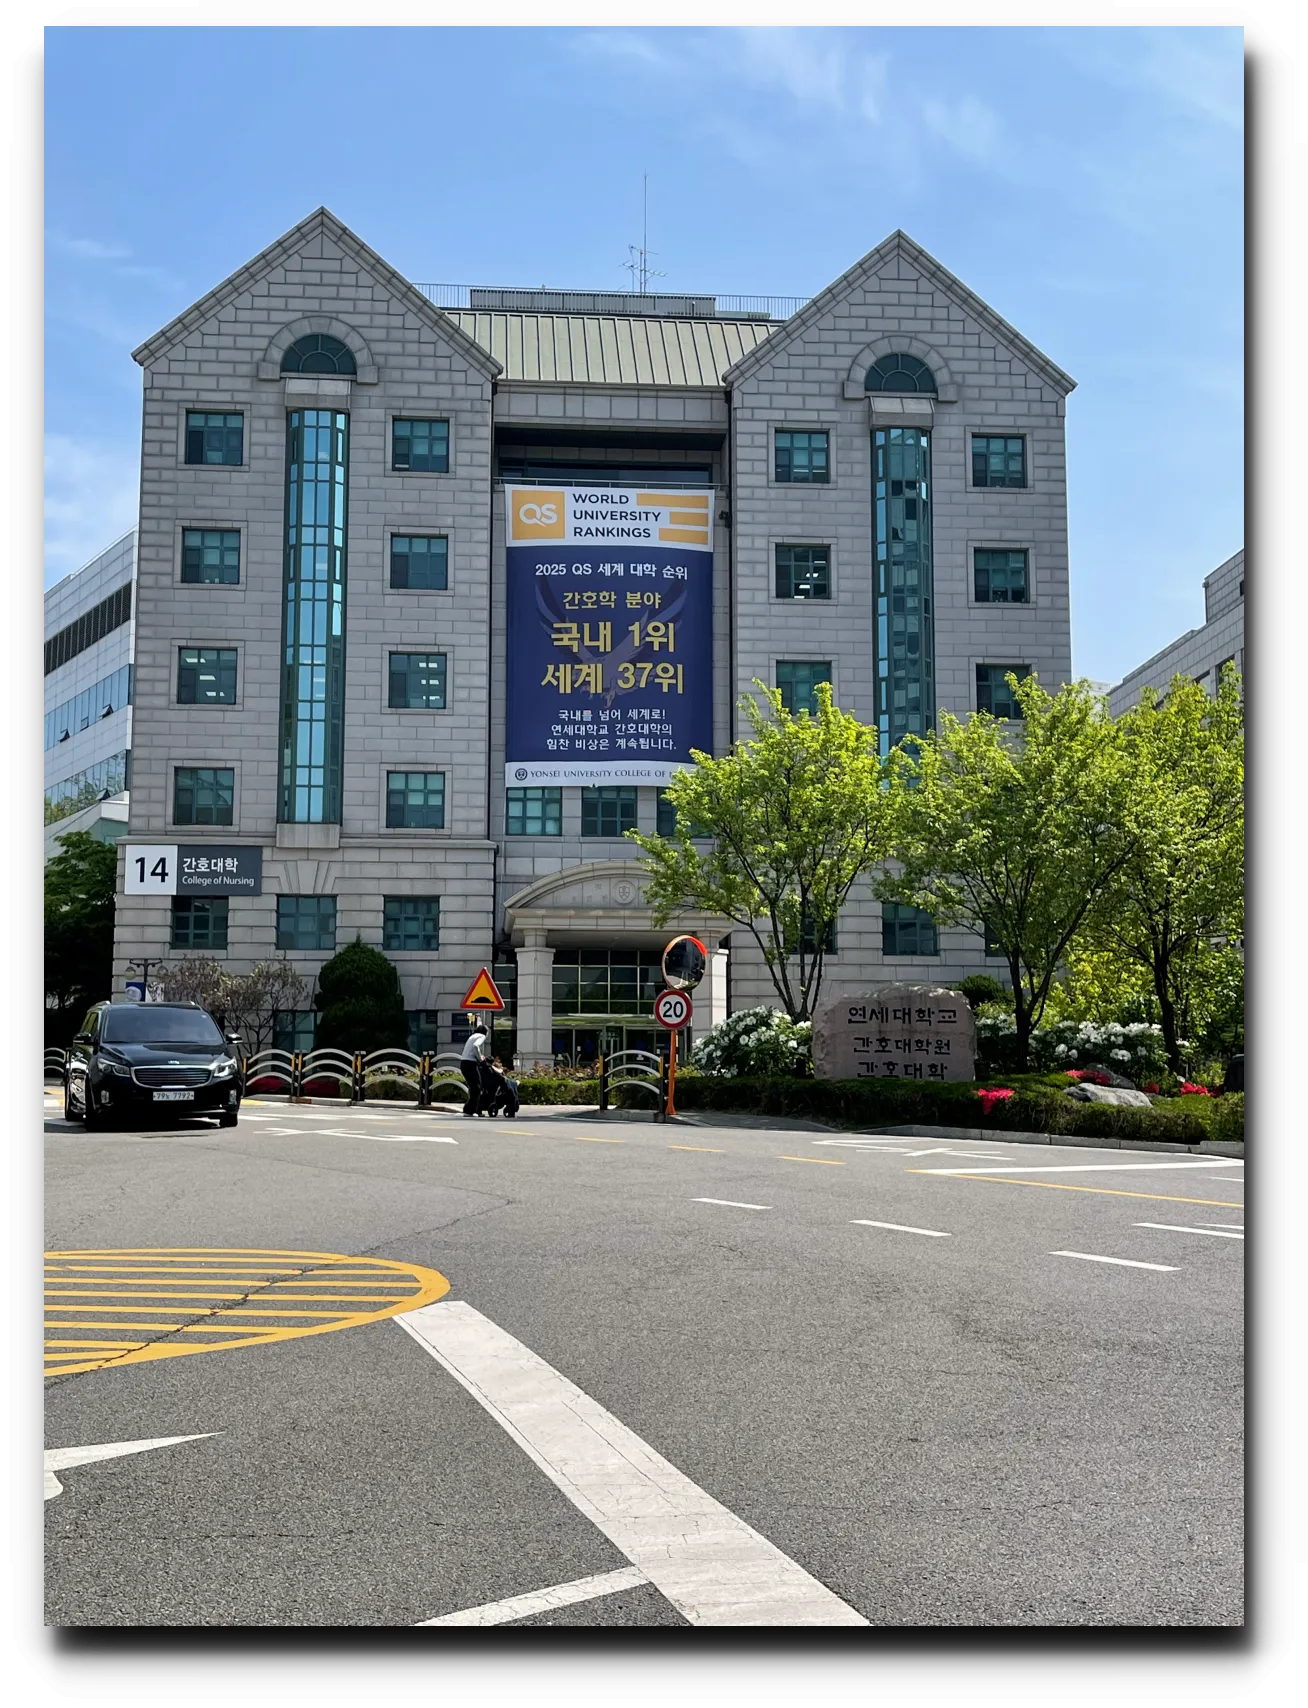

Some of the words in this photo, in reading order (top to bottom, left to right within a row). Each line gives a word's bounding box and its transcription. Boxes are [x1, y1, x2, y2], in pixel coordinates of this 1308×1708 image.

[573, 493, 629, 504] WORLD
[519, 503, 558, 527] QS
[573, 510, 661, 522] UNIVERSITY
[573, 527, 651, 538] RANKINGS
[535, 564, 566, 576] 2025
[572, 563, 592, 576] QS
[597, 563, 624, 577] 세계
[630, 563, 657, 577] 대학
[662, 565, 688, 580] 순위
[563, 591, 617, 609] 간호학
[626, 591, 661, 609] 분야
[551, 621, 612, 652] 국내
[628, 621, 675, 652] 1위
[541, 663, 603, 694] 세계
[617, 662, 683, 694] 37위
[558, 709, 593, 721] 국내를
[599, 709, 621, 721] 넘어
[627, 708, 666, 720] 세계로!
[551, 724, 608, 736] 연세대학교
[615, 723, 672, 735] 간호대학의
[546, 738, 569, 750] 힘찬
[575, 738, 610, 750] 비상은
[615, 738, 677, 750] 계속됩니다.
[530, 770, 561, 778] YONSEI
[564, 769, 612, 778] UNIVERSITY
[615, 769, 651, 777] COLLEGE
[654, 770, 666, 778] OF
[135, 857, 169, 883] 14
[182, 857, 239, 873] 간호대학
[182, 875, 212, 886] College
[213, 875, 222, 885] of
[223, 876, 255, 887] Nursing
[662, 1000, 684, 1018] 20
[848, 1006, 957, 1026] 연세대학교
[853, 1036, 951, 1055] 간호대학원
[856, 1060, 948, 1081] 간호대학
